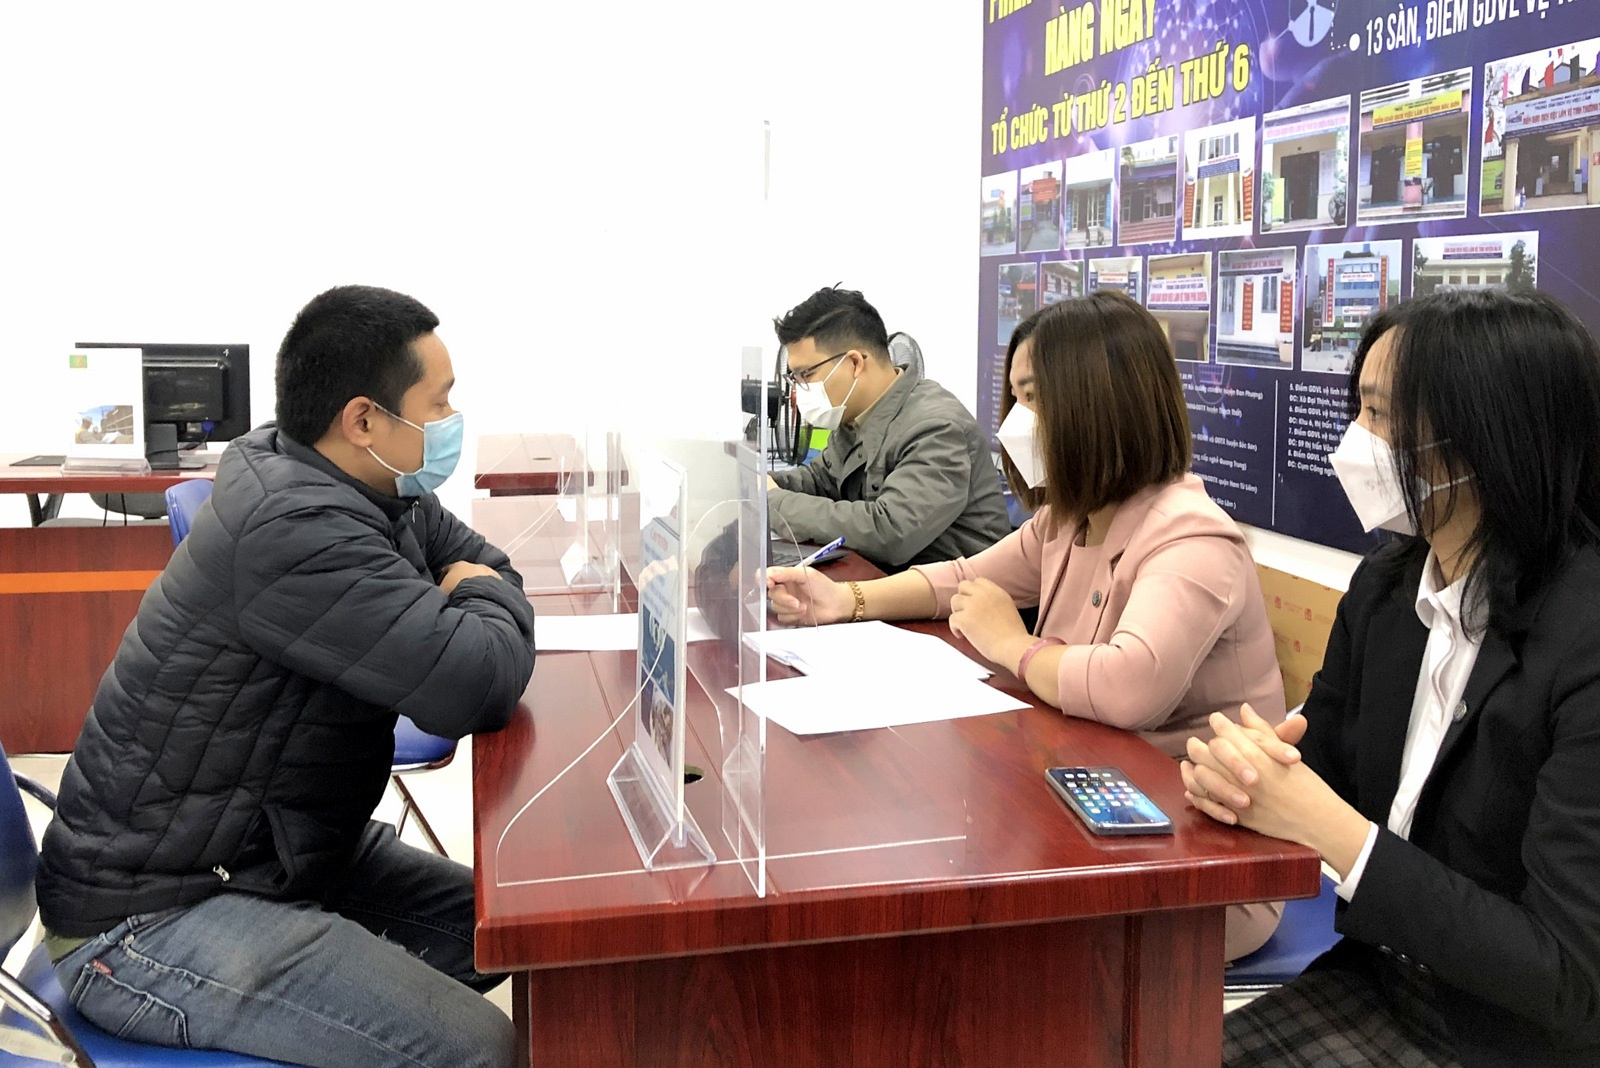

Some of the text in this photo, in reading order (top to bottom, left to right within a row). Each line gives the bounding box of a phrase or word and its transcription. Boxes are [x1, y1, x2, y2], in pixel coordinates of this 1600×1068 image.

[1044, 1, 1095, 76] HÀNG
[1366, 16, 1384, 56] 13
[1386, 3, 1421, 51] SÀN,
[991, 40, 1250, 155] TỔ CHỨC TỪ THỨ 2 ĐẾN THỨ 6
